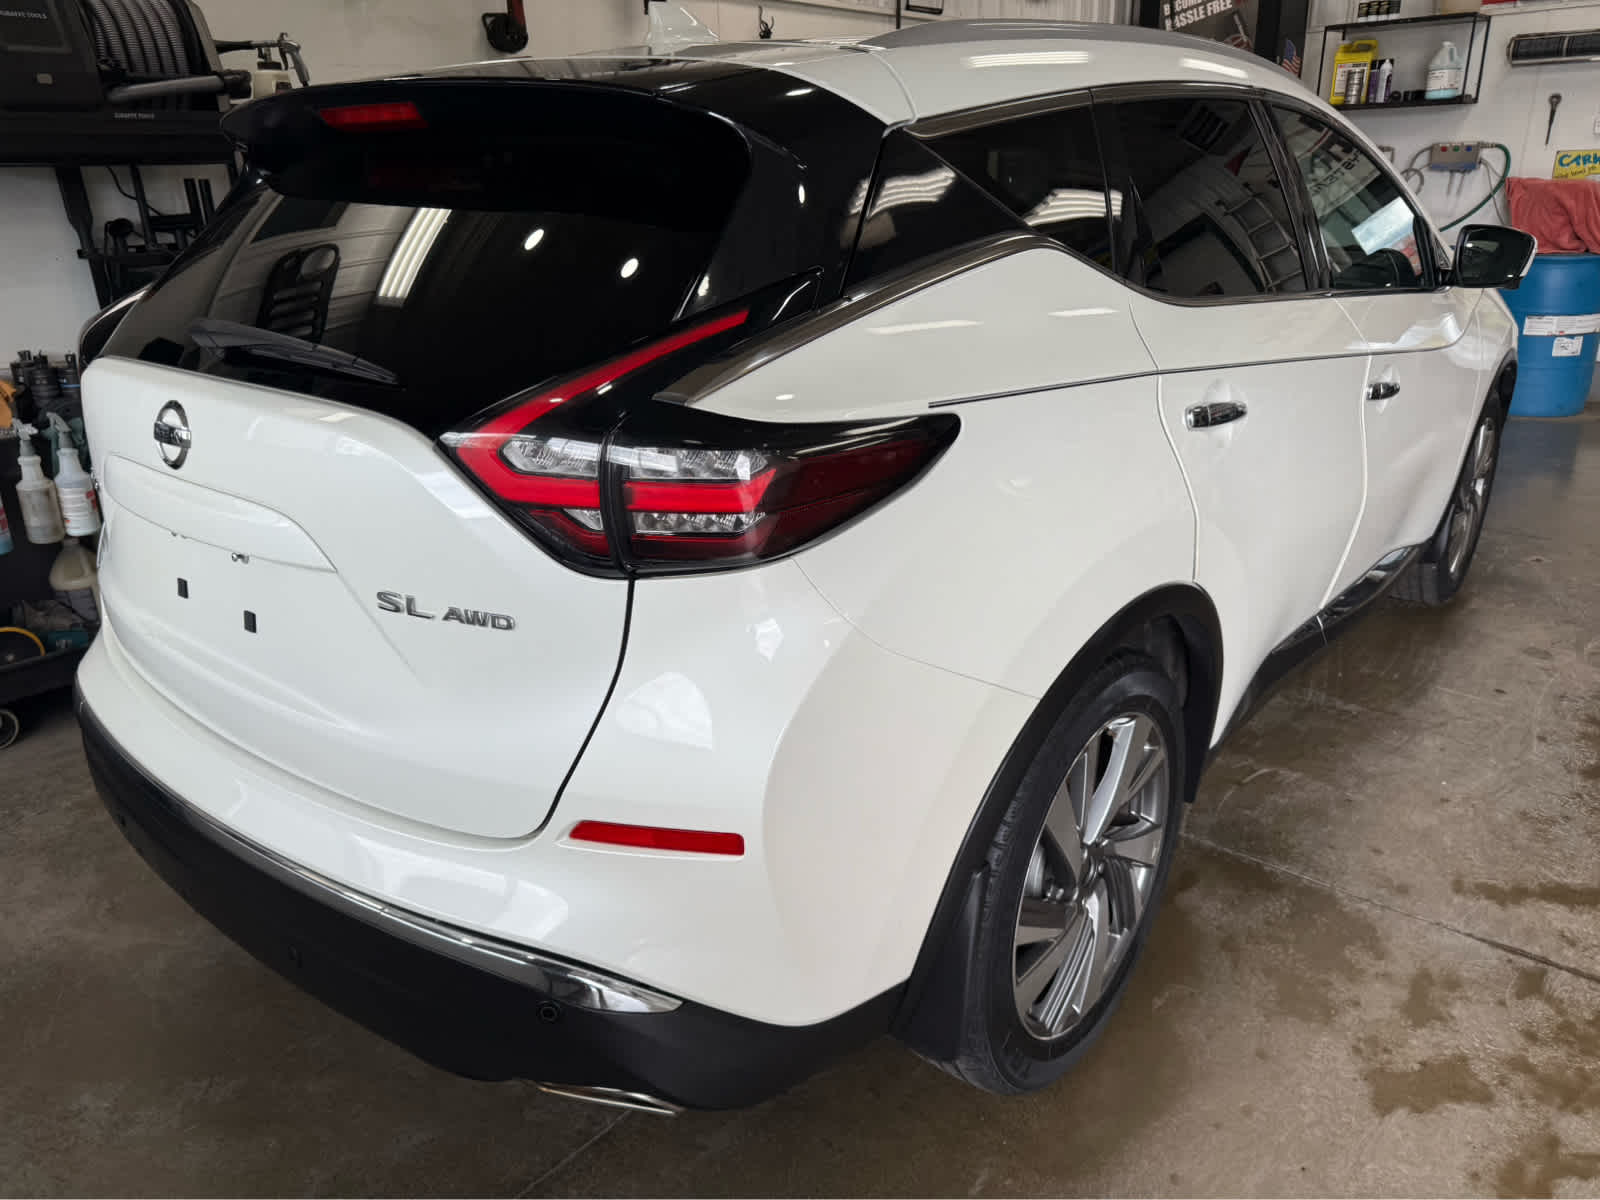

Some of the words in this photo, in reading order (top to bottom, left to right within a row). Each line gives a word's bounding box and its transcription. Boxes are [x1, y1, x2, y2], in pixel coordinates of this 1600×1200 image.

[1206, 0, 1233, 16] FREE
[376, 590, 436, 620] SL
[442, 606, 516, 630] AWD
